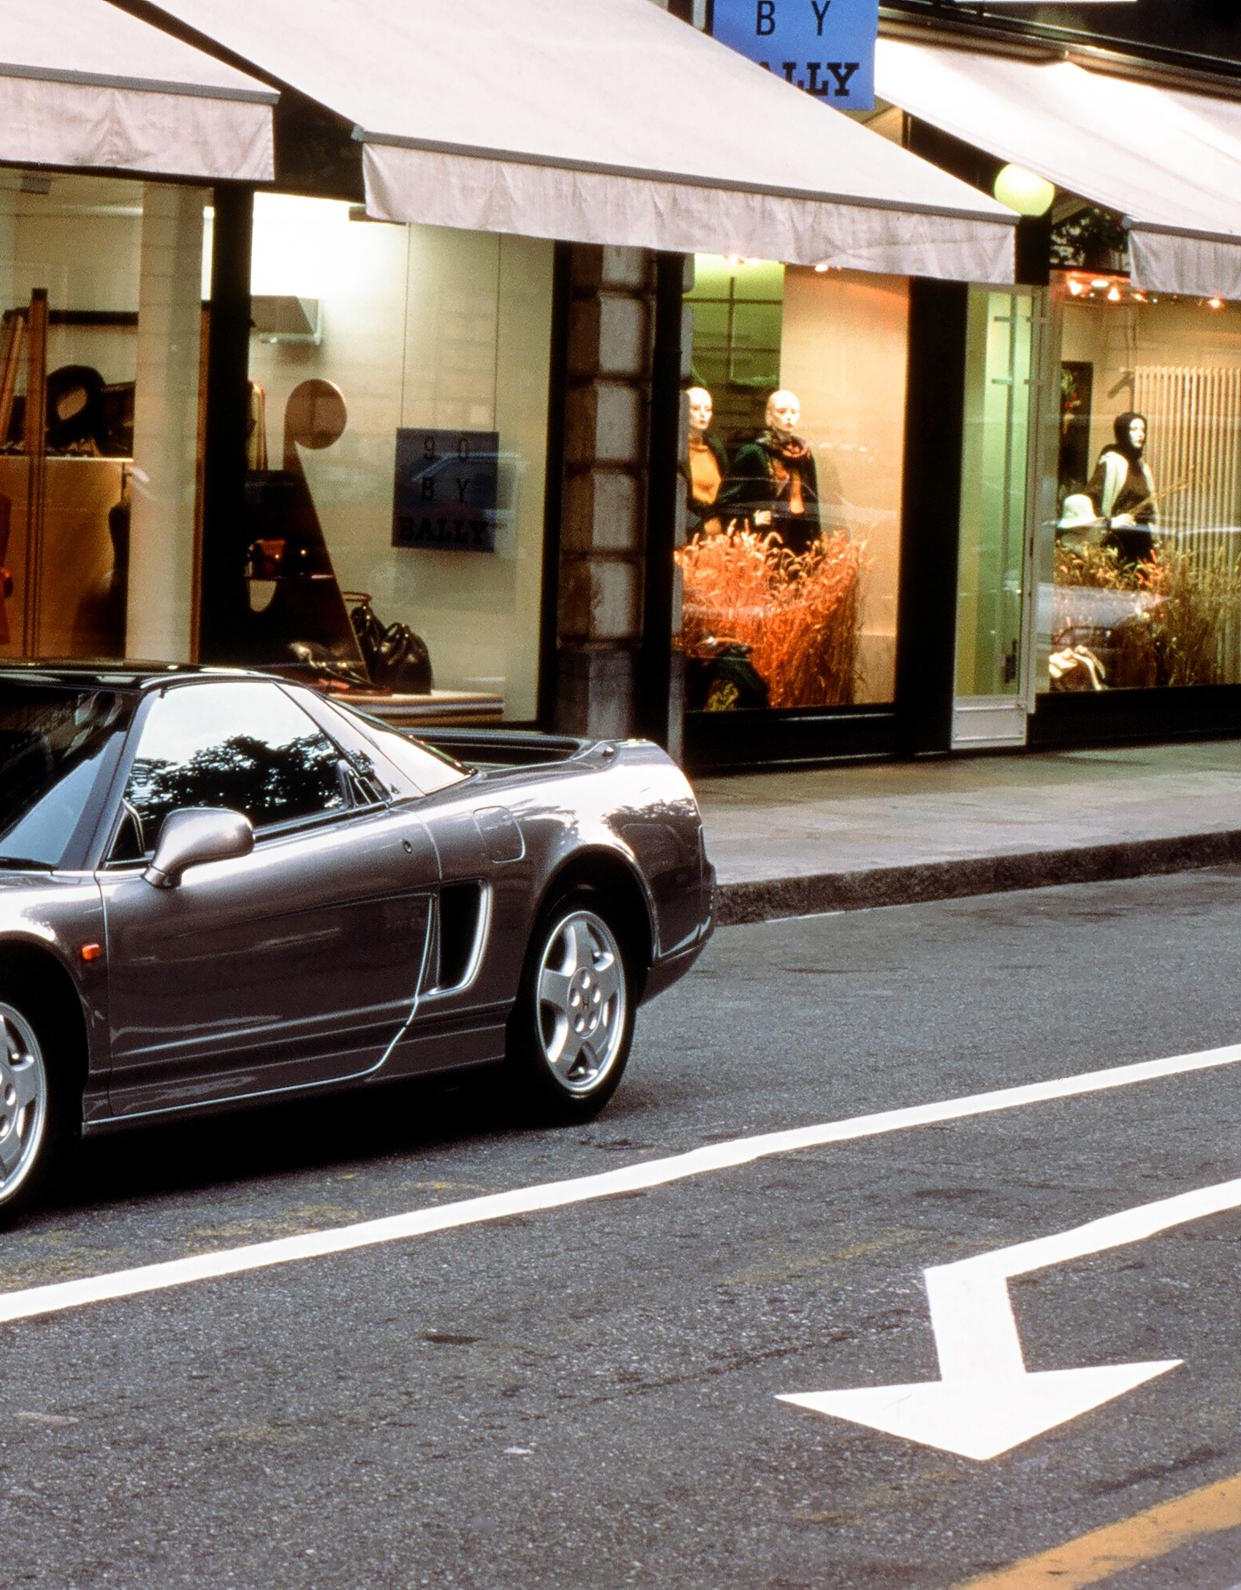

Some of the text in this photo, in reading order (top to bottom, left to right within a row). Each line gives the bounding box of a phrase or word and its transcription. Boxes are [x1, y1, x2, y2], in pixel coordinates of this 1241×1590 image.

[756, 0, 831, 36] BY
[760, 61, 859, 96] LLY
[422, 477, 470, 502] BY
